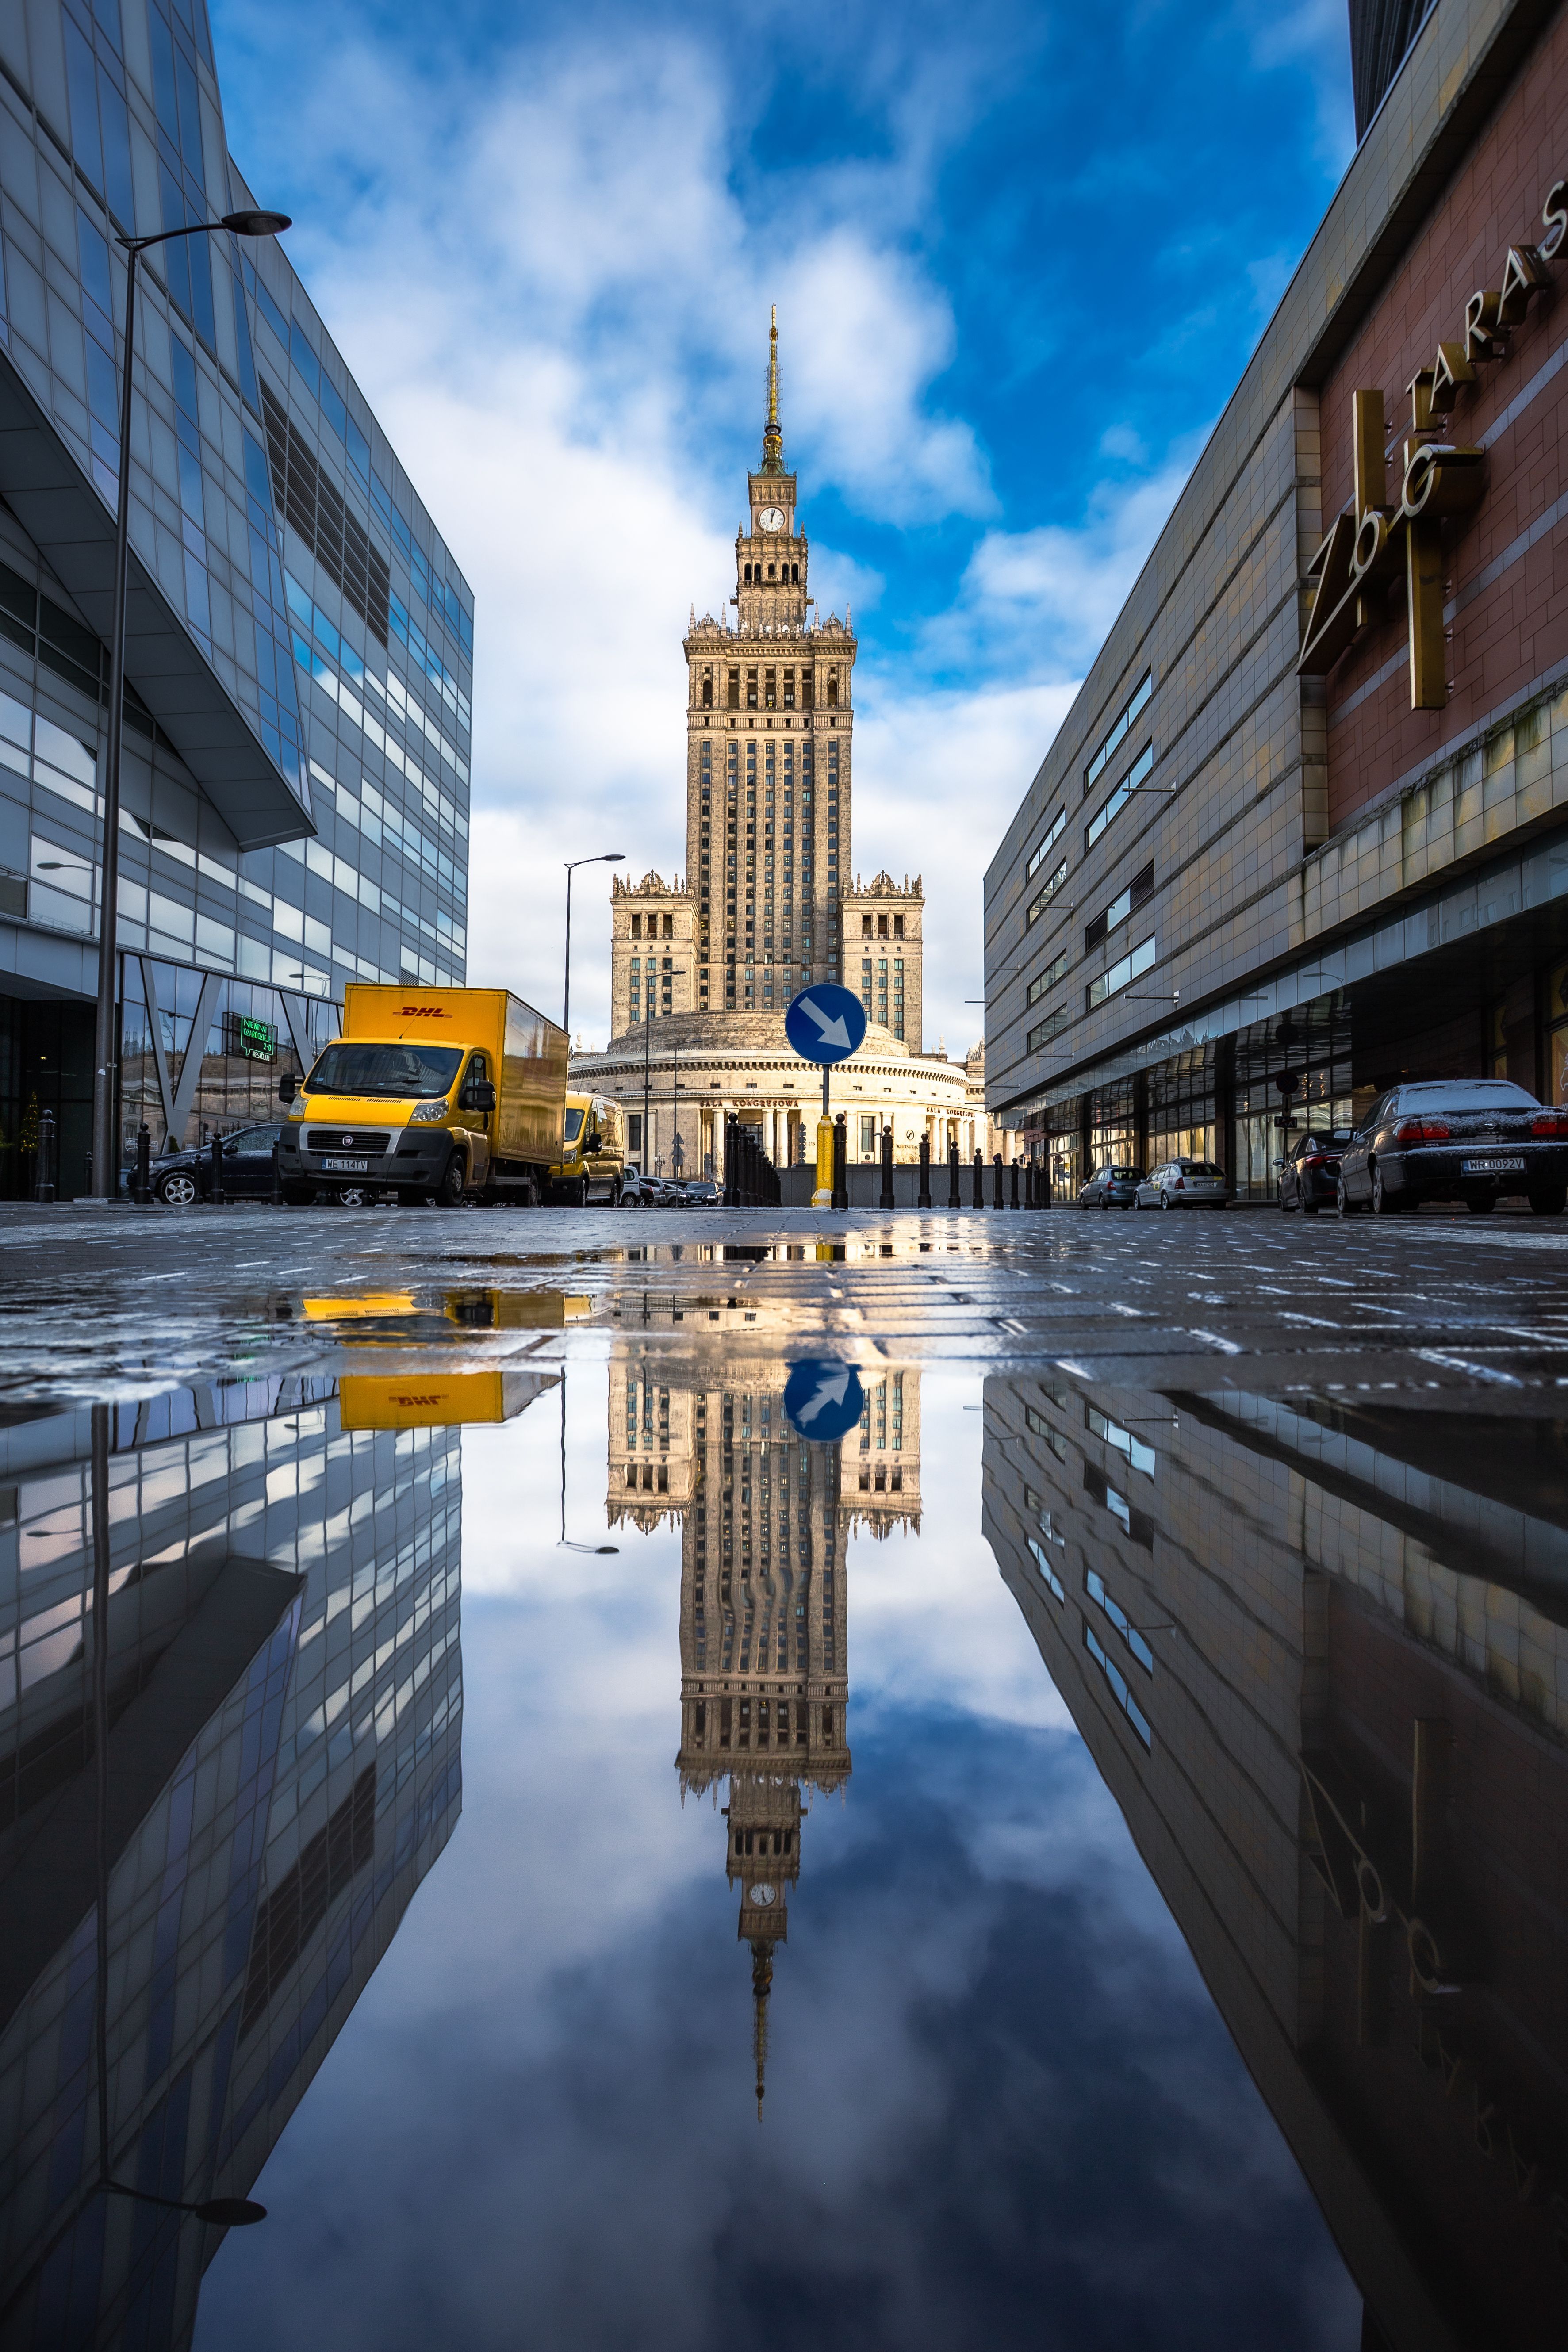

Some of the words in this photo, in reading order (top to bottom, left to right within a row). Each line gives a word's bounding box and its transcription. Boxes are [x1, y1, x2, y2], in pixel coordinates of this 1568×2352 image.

[400, 1007, 446, 1018] DHL
[253, 1051, 270, 1061] RESTCLUB
[327, 1160, 338, 1168] WE
[341, 1160, 366, 1169] 114TV
[1470, 1160, 1486, 1170] WR
[1489, 1159, 1522, 1168] 0092V
